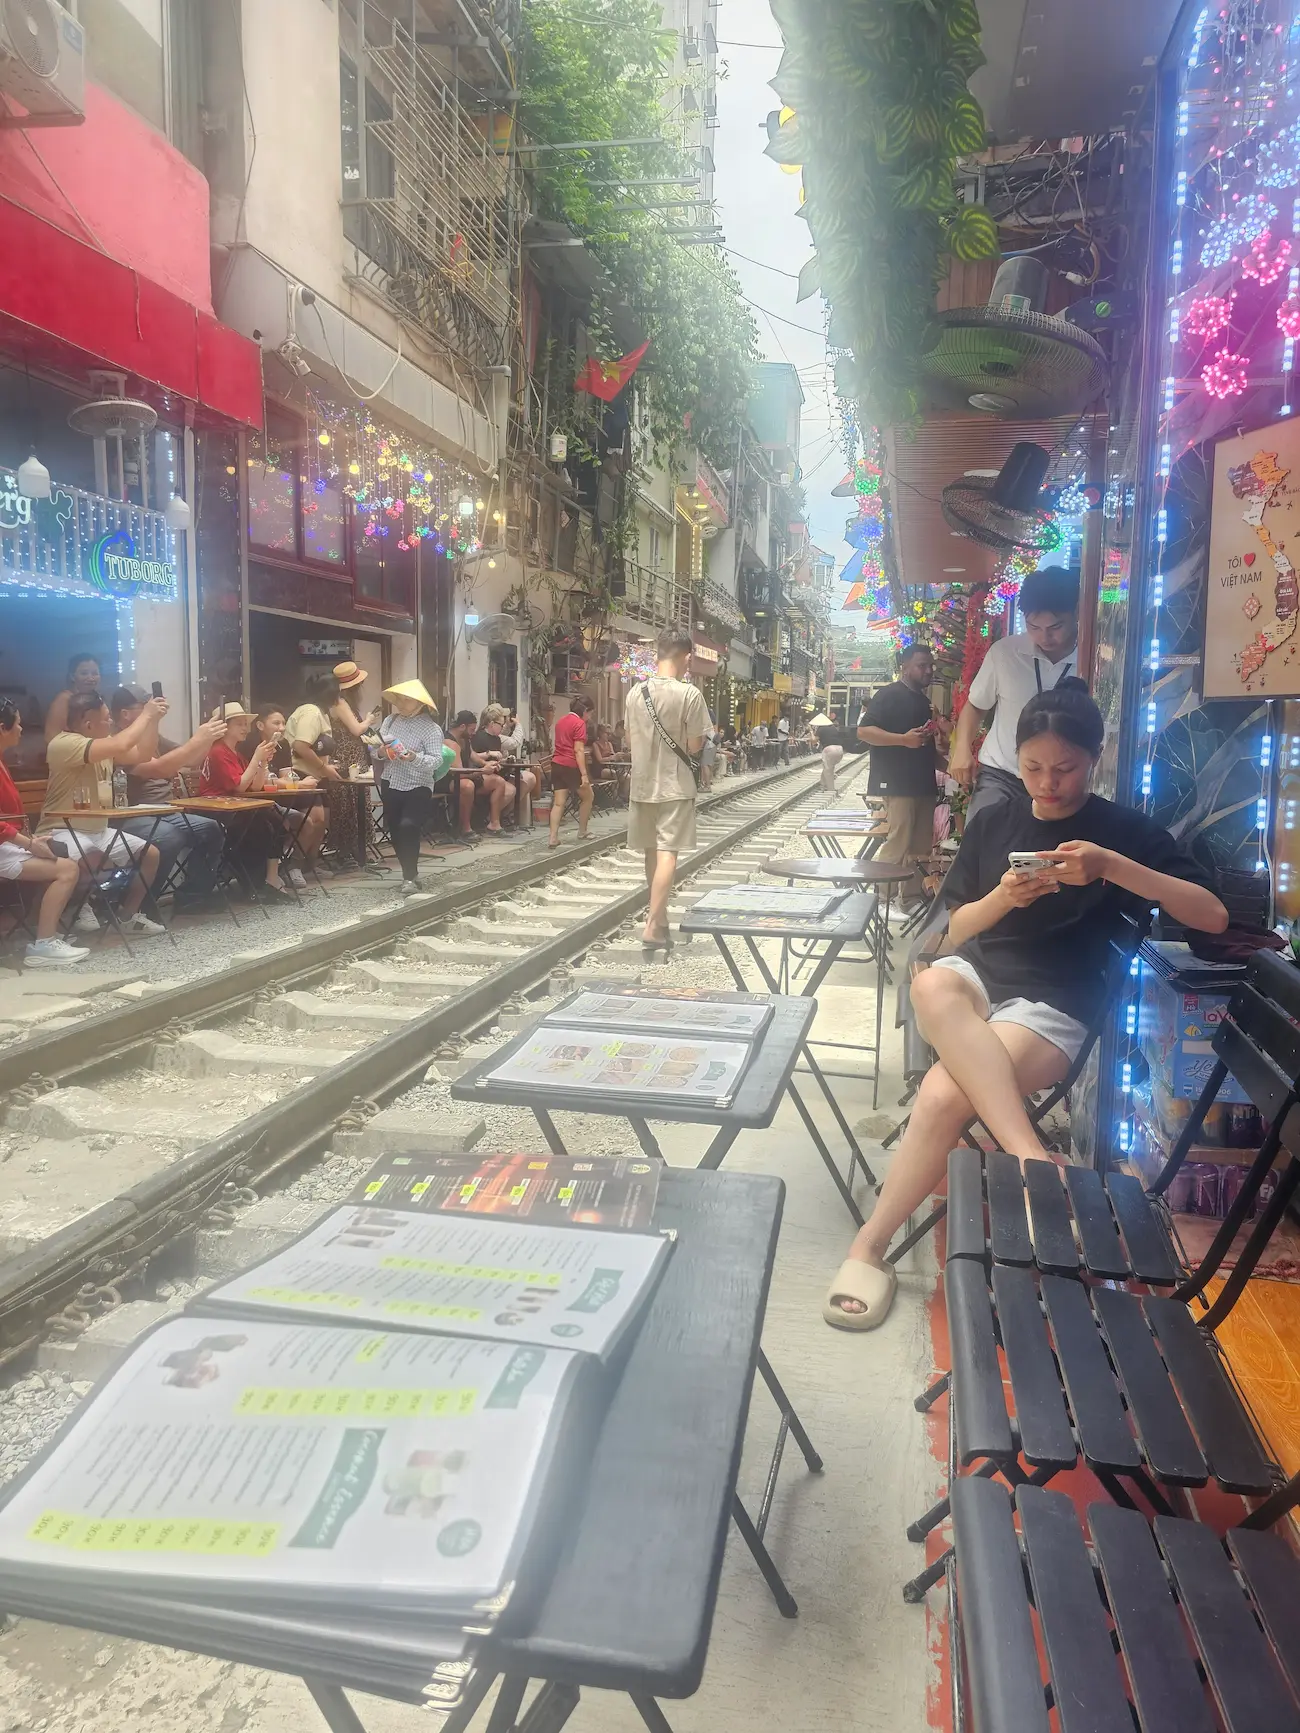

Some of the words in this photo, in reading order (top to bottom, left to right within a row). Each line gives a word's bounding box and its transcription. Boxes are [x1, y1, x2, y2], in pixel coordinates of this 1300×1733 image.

[104, 552, 174, 588] TUBORG
[1228, 555, 1242, 570] TÔI
[1220, 573, 1238, 589] VIỆT
[1239, 571, 1262, 585] NAM
[344, 1430, 379, 1484] Coconut
